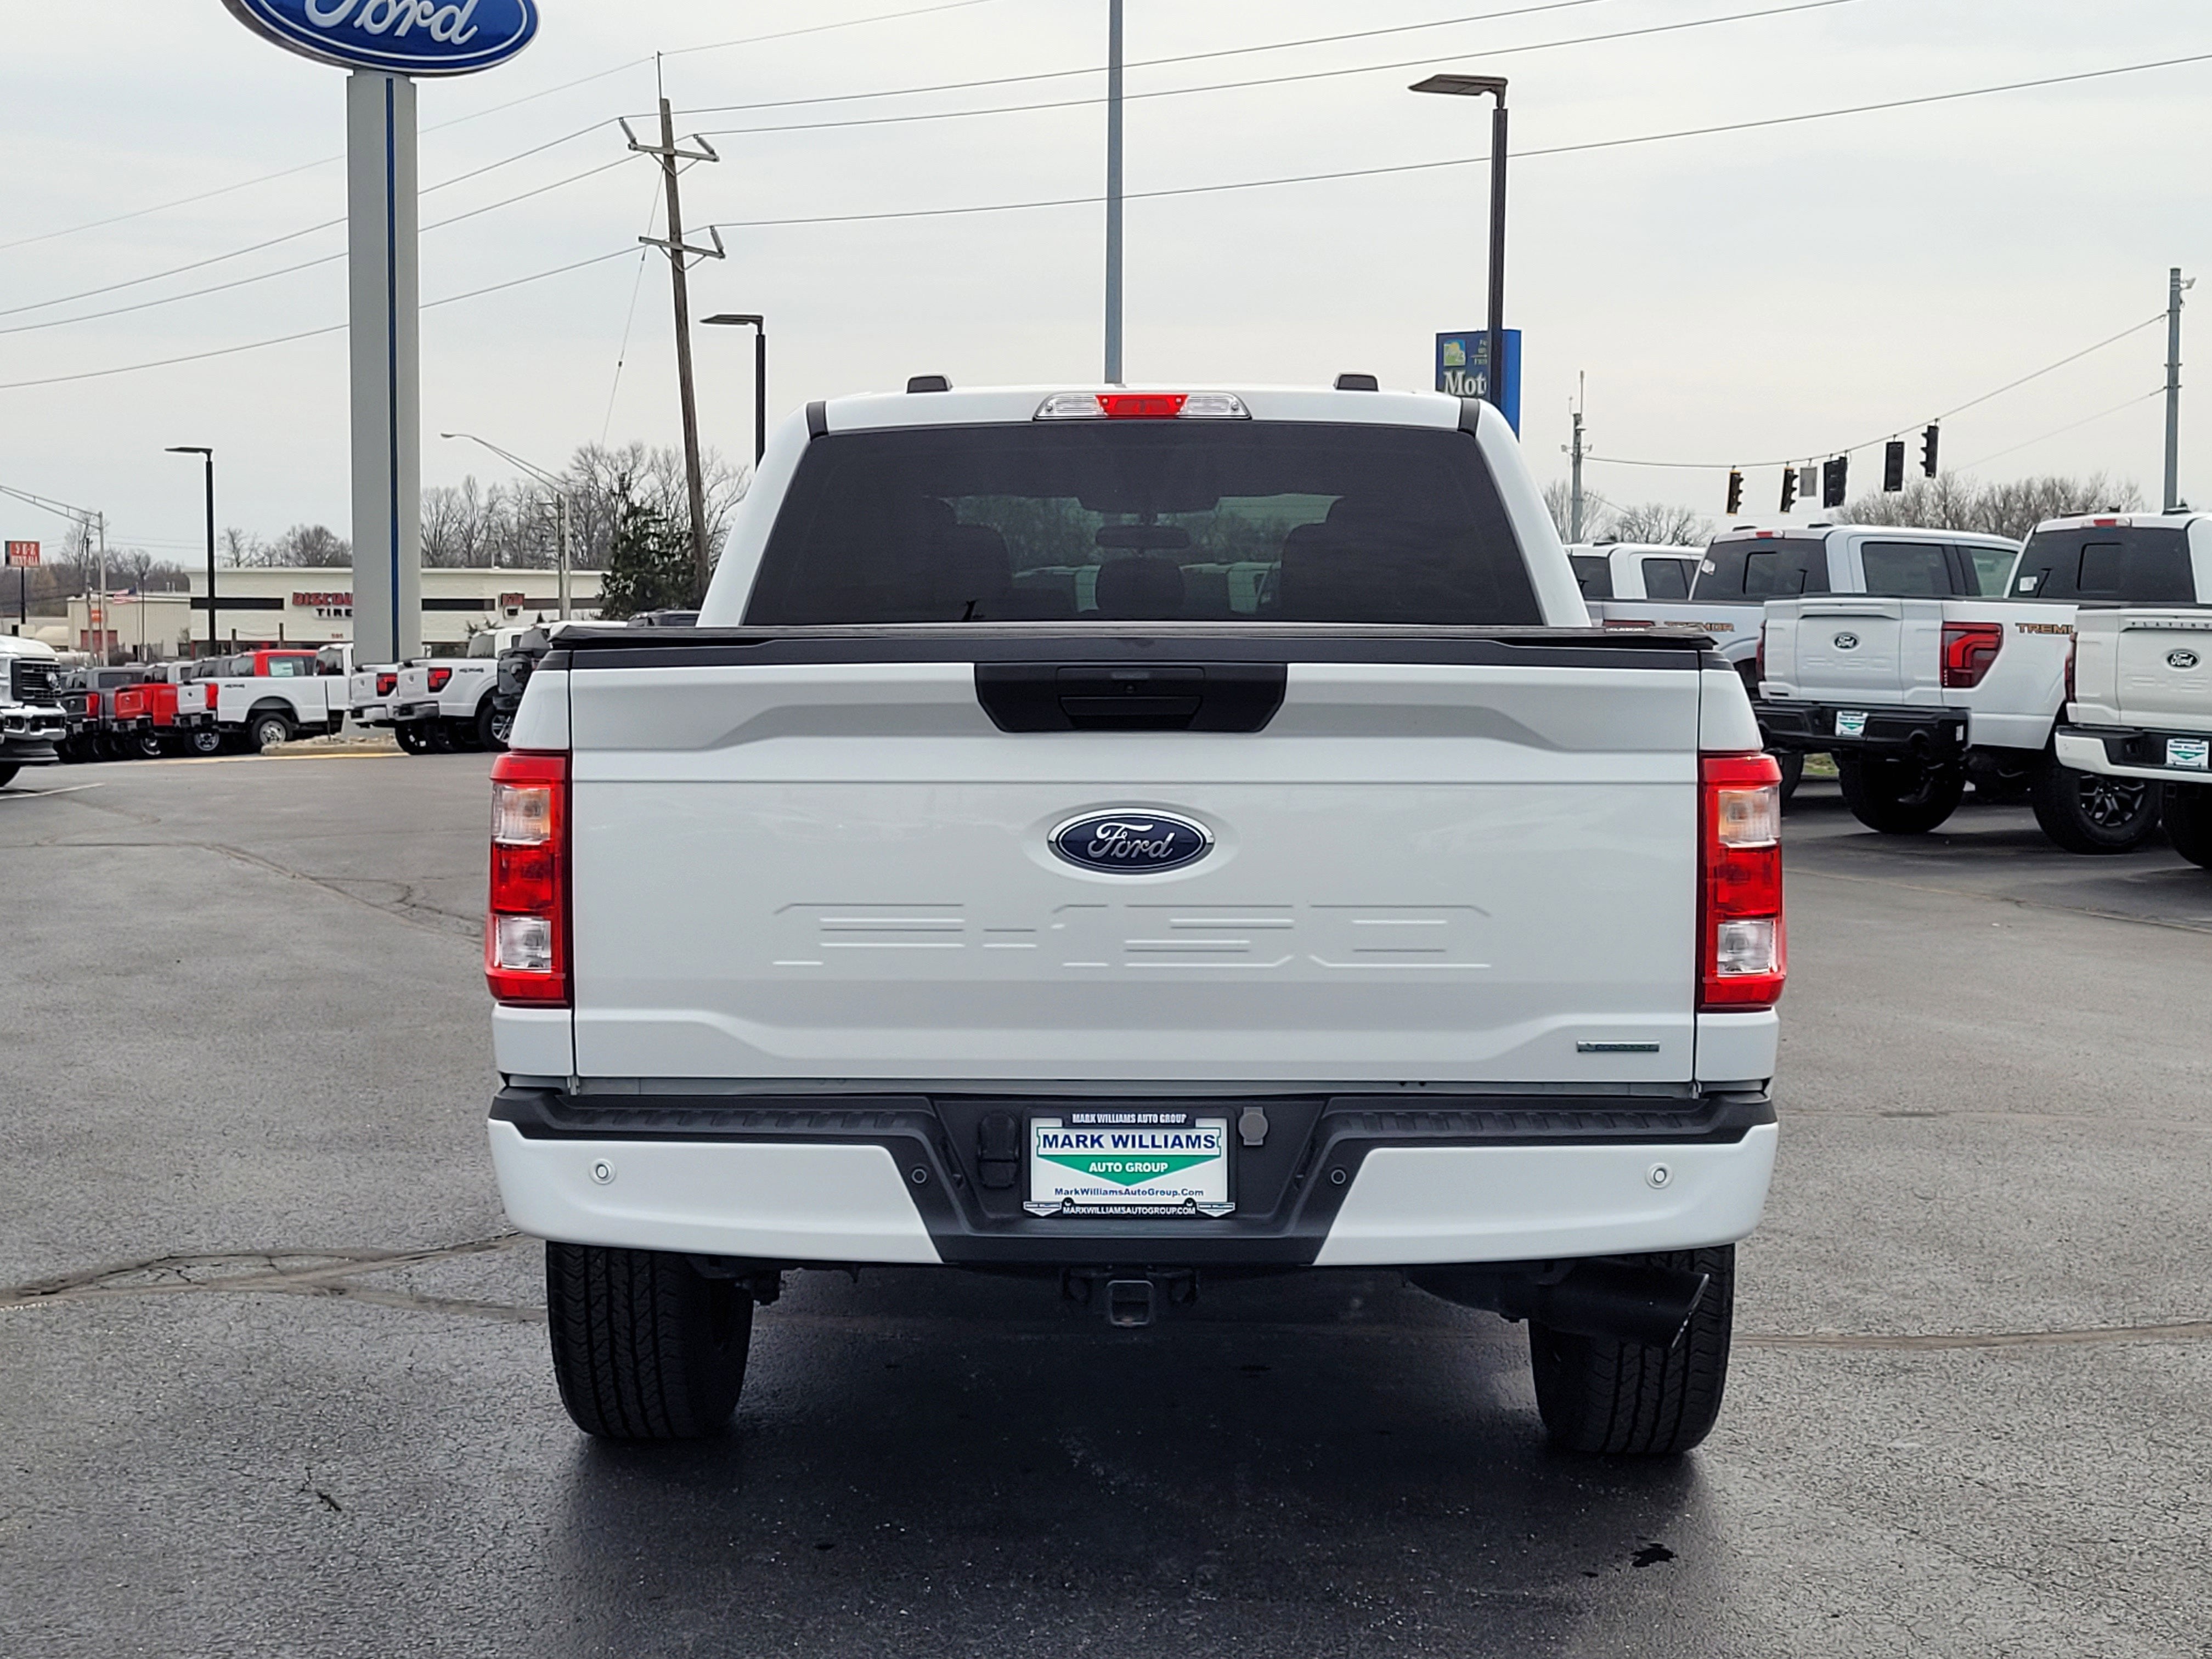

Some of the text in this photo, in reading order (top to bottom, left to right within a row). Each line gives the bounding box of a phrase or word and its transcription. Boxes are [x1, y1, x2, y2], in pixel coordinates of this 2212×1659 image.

[315, 608, 353, 617] TIRE
[1087, 822, 1175, 858] Ford
[1072, 1113, 1187, 1124] MARK WILLIAMS AUTO GROUP
[1042, 1134, 1216, 1149] MARK WILLIAMS
[1089, 1162, 1168, 1173] AUTO GROUP
[1054, 1188, 1204, 1198] MarkWilliamsAutoGroup.Com
[1062, 1206, 1196, 1215] MARKWILLIAMSAUTOGROUP.COM
